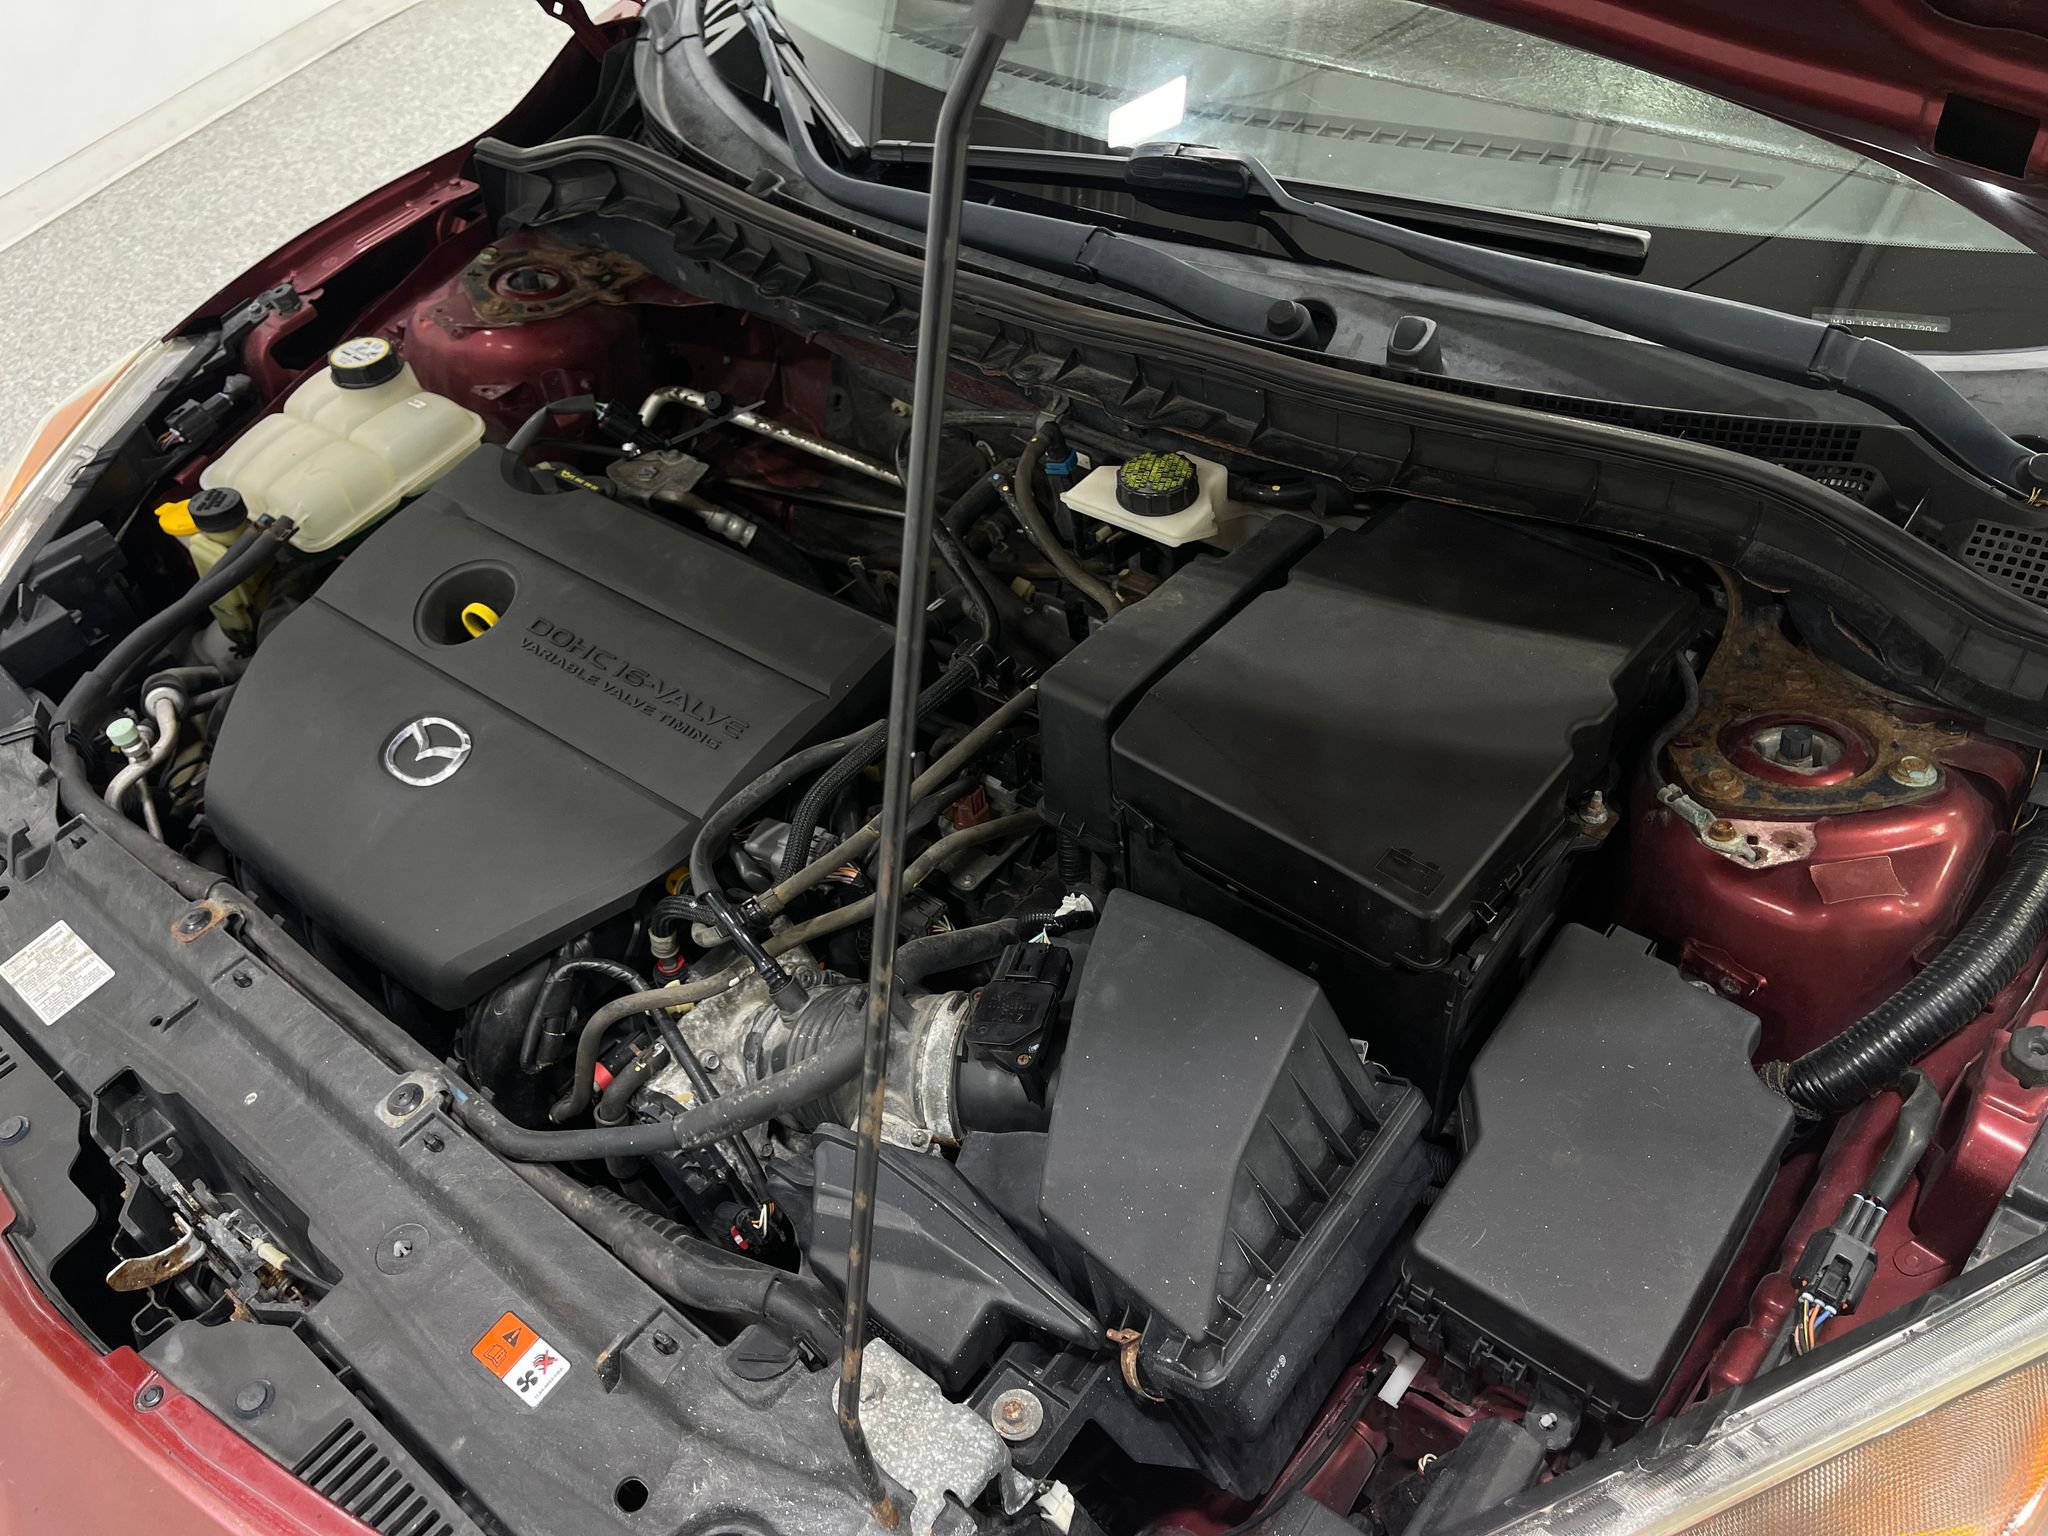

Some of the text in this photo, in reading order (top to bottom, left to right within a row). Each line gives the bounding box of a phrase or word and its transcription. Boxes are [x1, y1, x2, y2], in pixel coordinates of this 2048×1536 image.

[520, 638, 723, 750] VARIABLE VALVE TIMING
[527, 616, 751, 740] DOHC 16-VALVE
